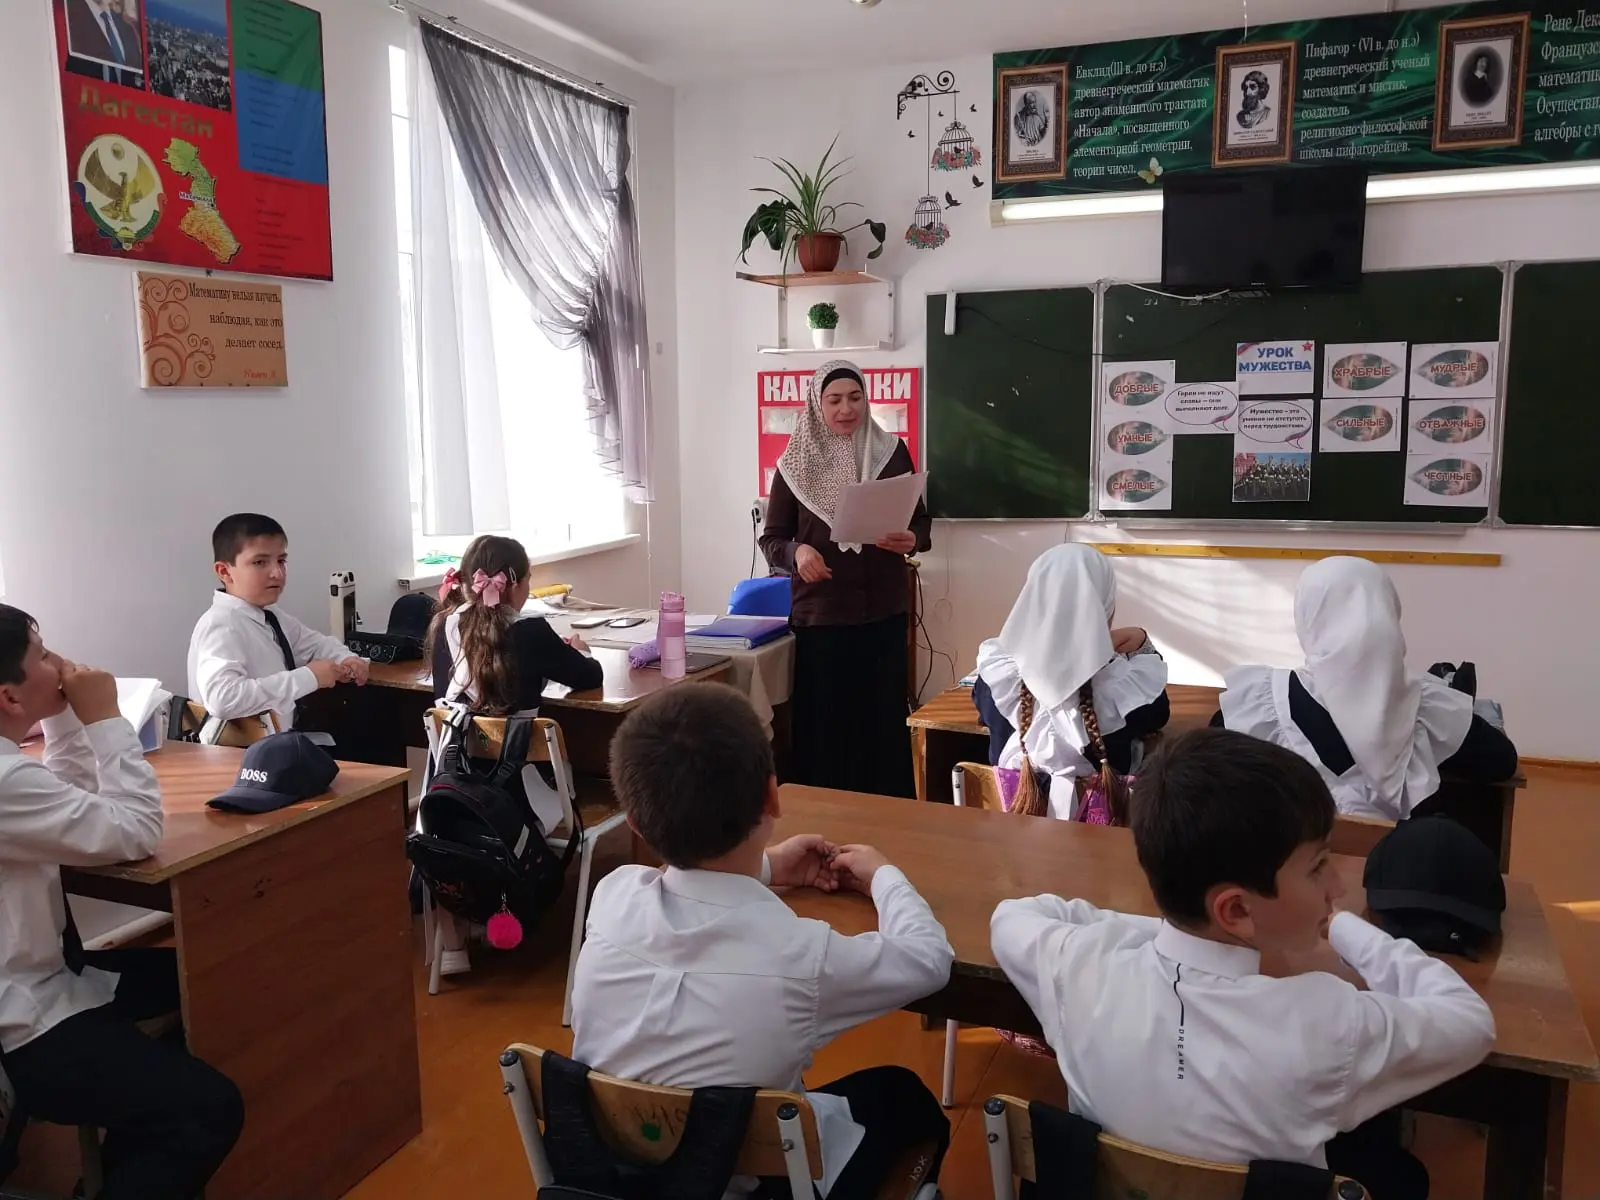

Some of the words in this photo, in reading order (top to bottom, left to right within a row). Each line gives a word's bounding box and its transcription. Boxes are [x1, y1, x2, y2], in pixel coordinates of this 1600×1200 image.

[1544, 14, 1573, 33] Рене
[1305, 42, 1350, 59] Пифагор
[1358, 37, 1374, 52] (VI
[1375, 39, 1385, 51] в.
[1387, 38, 1399, 51] до
[1401, 31, 1420, 49] н.э)
[1125, 61, 1134, 73] в.
[1135, 61, 1147, 74] до
[1149, 56, 1167, 72] н.э)
[1303, 58, 1389, 80] древнегреческий
[1390, 53, 1431, 73] ученый
[1074, 79, 1155, 100] древнегреческий
[1157, 77, 1210, 91] математик
[1302, 84, 1357, 99] математик
[1359, 83, 1366, 94] и
[79, 84, 214, 139] Дагестан
[1074, 107, 1101, 119] автор
[1102, 103, 1162, 117] знаменитого
[1164, 98, 1208, 113] трактата
[1301, 105, 1350, 119] создатель
[1537, 95, 1600, 117] Осуществи
[1123, 119, 1190, 135] посвященного
[1534, 121, 1582, 142] алгебры
[1584, 124, 1591, 137] с
[1073, 140, 1139, 158] элементарной
[1299, 148, 1333, 160] школы
[1335, 140, 1411, 159] пифагорейцев.
[1073, 166, 1105, 179] теории
[1107, 164, 1137, 175] чисел.
[188, 282, 231, 302] Математику
[209, 311, 253, 327] наблюдая,
[254, 316, 269, 327] как
[270, 317, 284, 328] это
[225, 338, 256, 349] делает
[1257, 347, 1294, 358] УРОК
[1238, 360, 1312, 372] МУЖЕСТВА
[1334, 365, 1391, 377] ХРАБРЫЕ
[1430, 362, 1477, 374] МУДРЫЕ
[763, 372, 911, 402] КАРКИ
[1114, 383, 1159, 394] ДОБРЫЕ
[1336, 417, 1385, 428] СИЛЬНЫЕ
[1419, 417, 1483, 429] ОТВАЖНЫЕ
[1117, 434, 1153, 443] УМНЫЕ
[1423, 471, 1472, 482] ЧЕСТНЫЕ
[1112, 481, 1156, 490] СМЕЛЫЕ
[240, 768, 268, 783] BOSS
[1177, 1028, 1185, 1080] DREAMER
